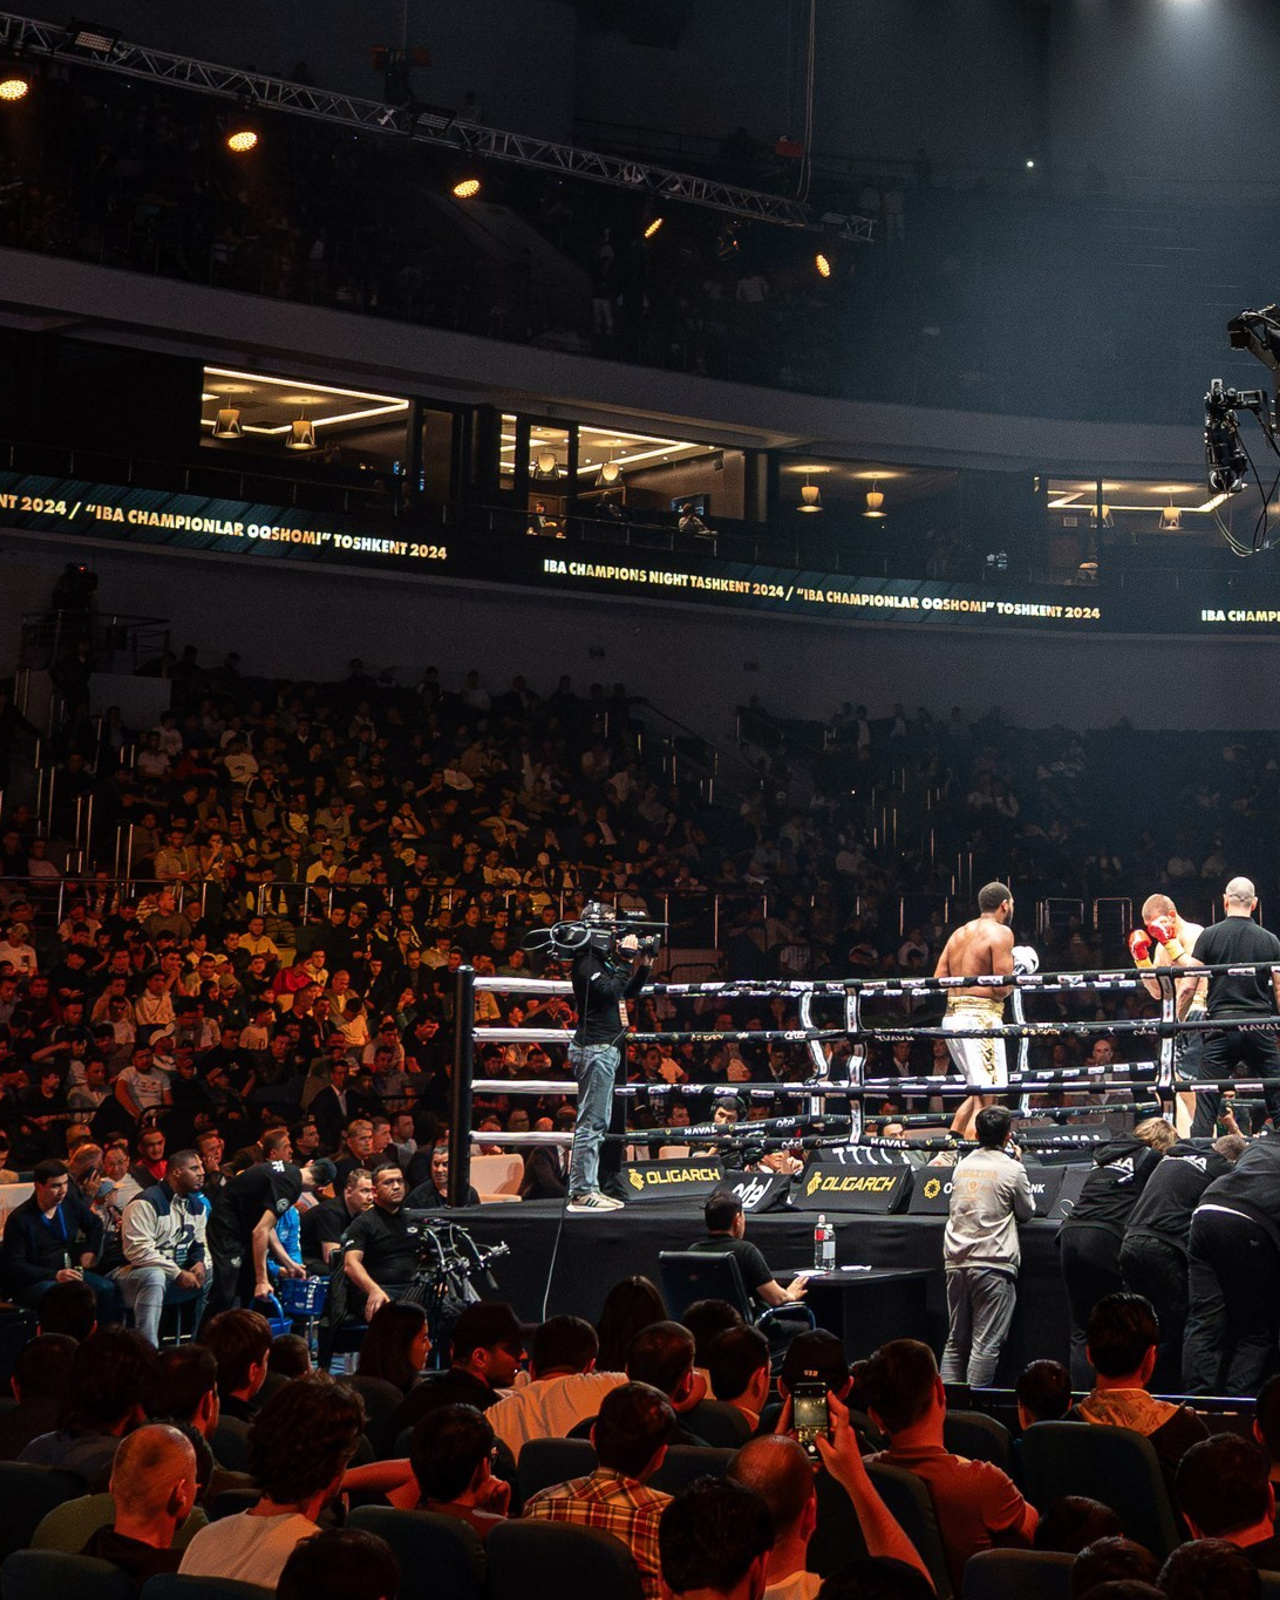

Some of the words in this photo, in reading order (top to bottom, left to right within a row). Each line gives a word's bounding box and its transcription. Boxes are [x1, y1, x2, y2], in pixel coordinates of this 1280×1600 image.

[20, 494, 67, 516] 2024
[127, 509, 245, 537] CHAMPIONLAR
[333, 533, 409, 555] TOSHKENT
[409, 542, 448, 561] 2024
[544, 558, 567, 575] IBA
[568, 561, 648, 584] CHAMPIONS
[648, 568, 690, 588] NIGHT
[689, 574, 751, 595] TASHKENT
[752, 582, 785, 600] 2024
[825, 590, 920, 610] CHAMPIONLAR
[996, 601, 1063, 619] TOSHKENT
[1063, 605, 1101, 620] 2024
[1201, 610, 1226, 623] IBA
[684, 1125, 719, 1136] HAVAL
[870, 1137, 911, 1149] HAVAL
[646, 1167, 722, 1185] OLIGARCH
[820, 1175, 897, 1193] OLIGARCH
